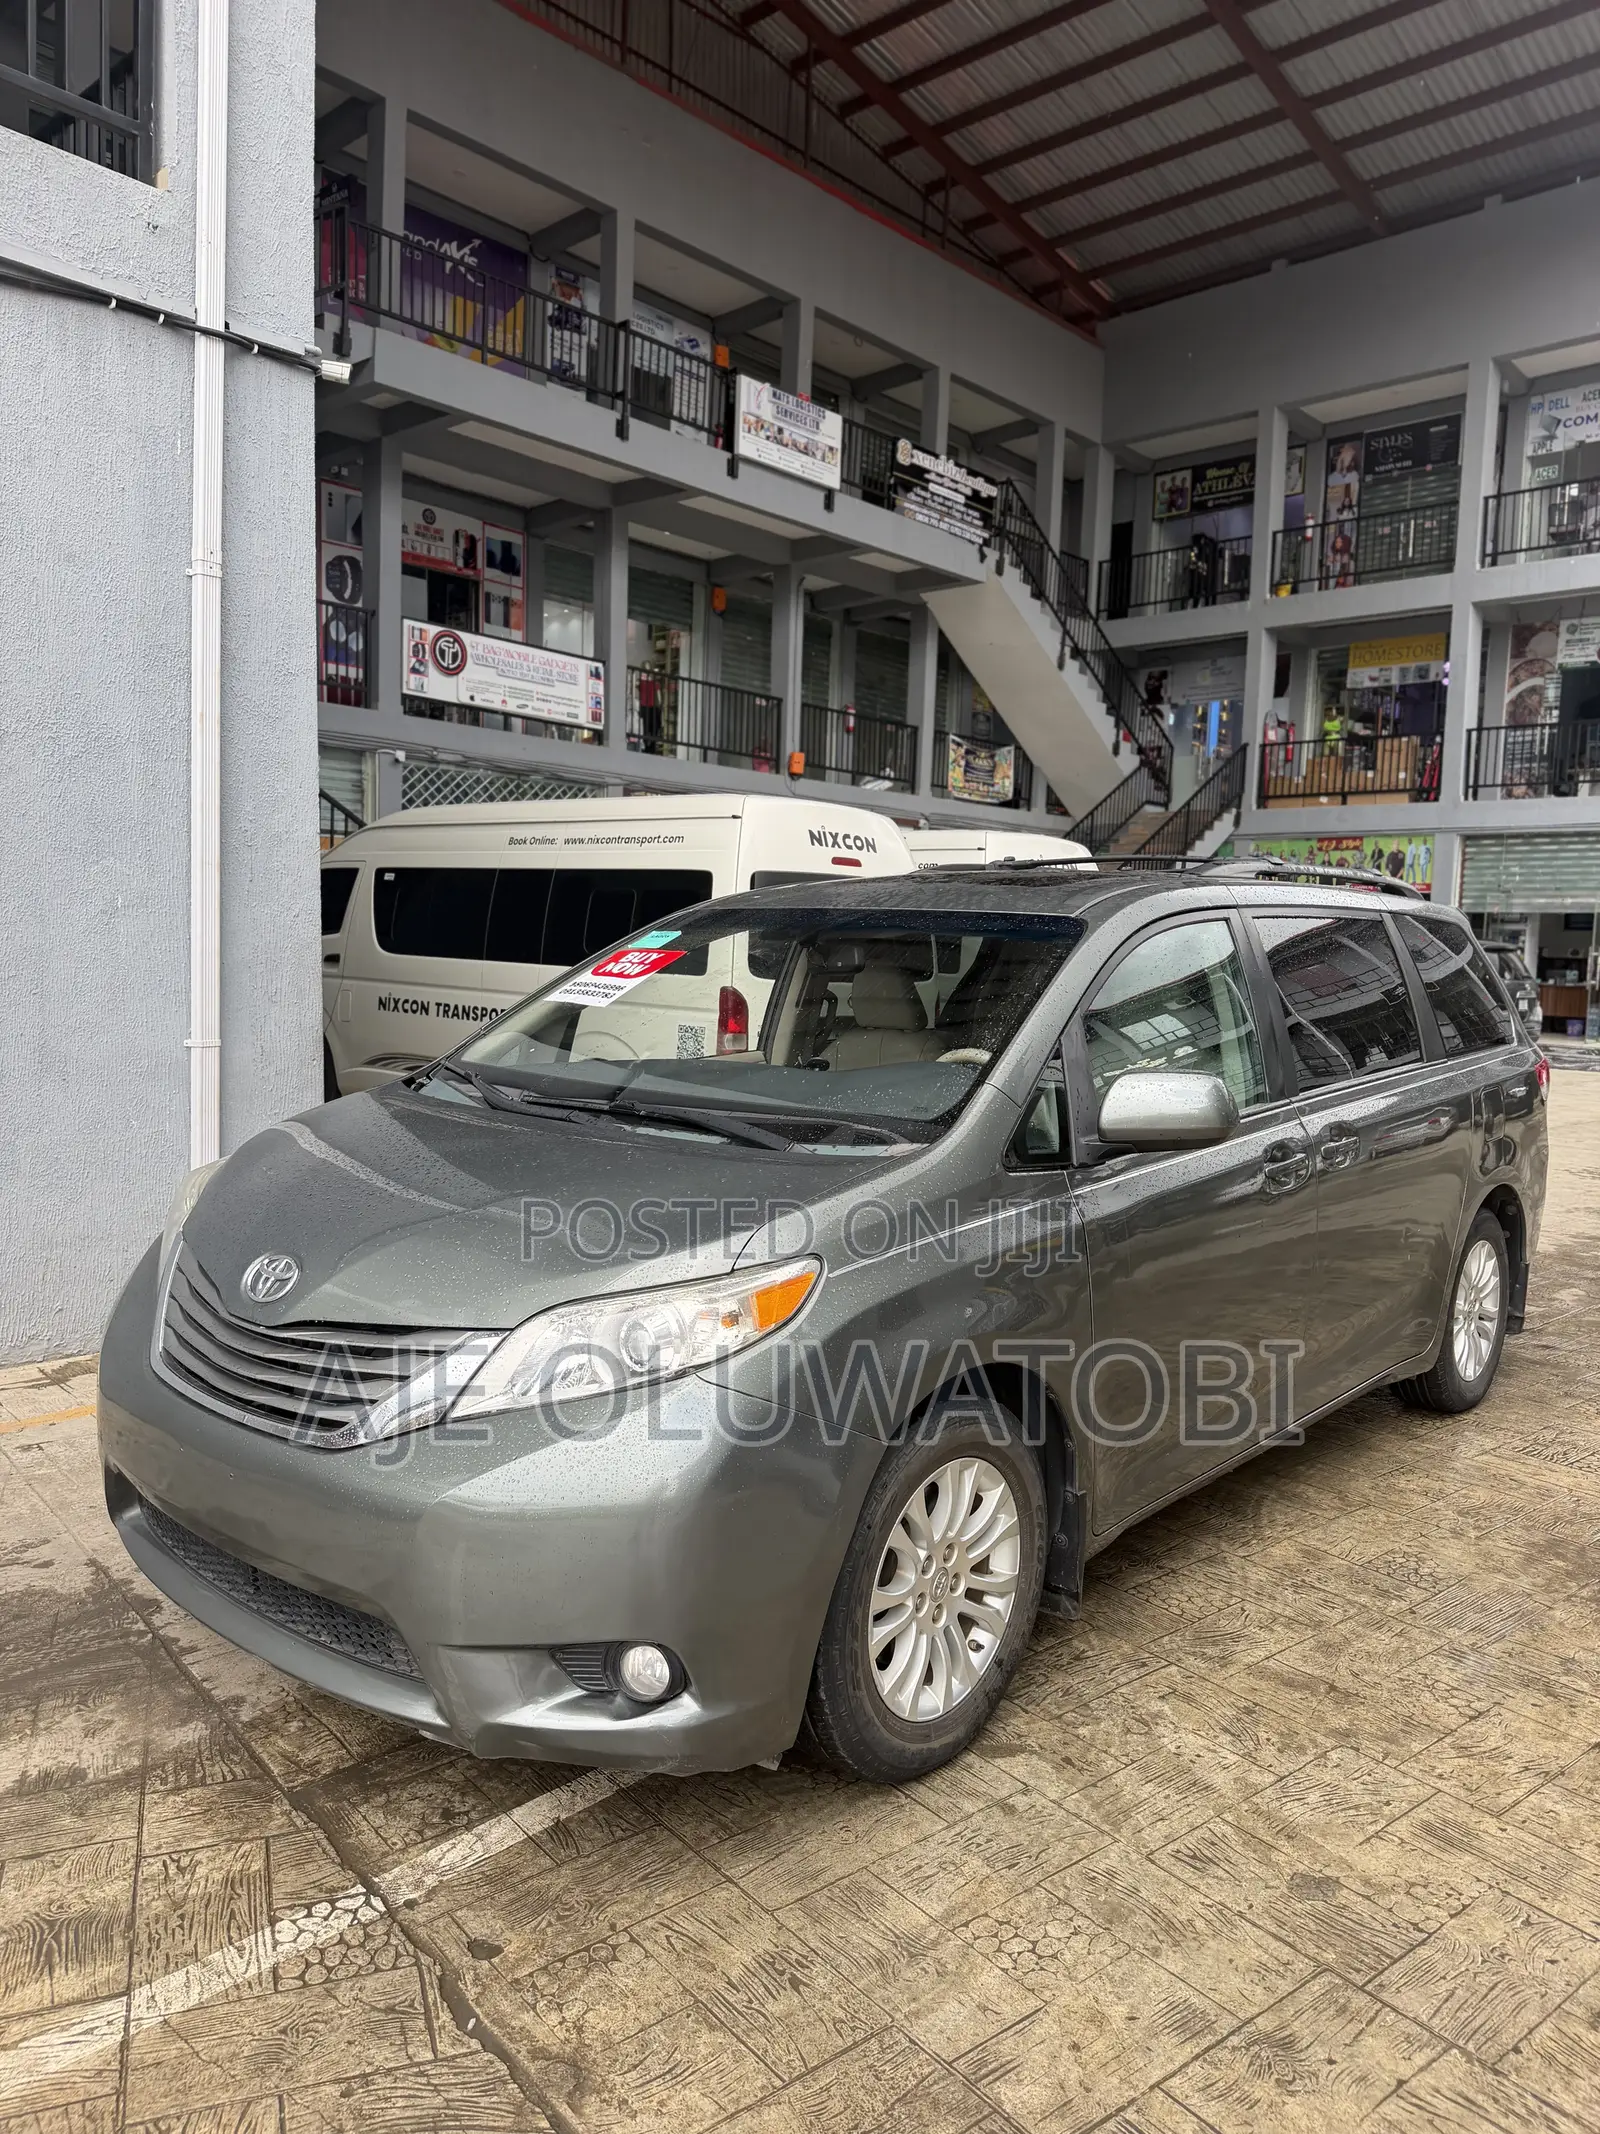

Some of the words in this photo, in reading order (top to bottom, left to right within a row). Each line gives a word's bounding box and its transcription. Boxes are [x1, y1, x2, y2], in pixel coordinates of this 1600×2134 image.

[791, 397, 826, 420] LOGISTICS
[1548, 396, 1570, 412] DELL
[775, 405, 808, 427] SERVICES
[1536, 466, 1557, 480] ACER
[1353, 642, 1441, 665] HOMESTORE
[508, 836, 528, 846] Book
[529, 835, 558, 846] Online:
[563, 834, 685, 848] www.nixcontransport.com
[619, 951, 665, 964] BUY
[598, 962, 651, 976] NOW
